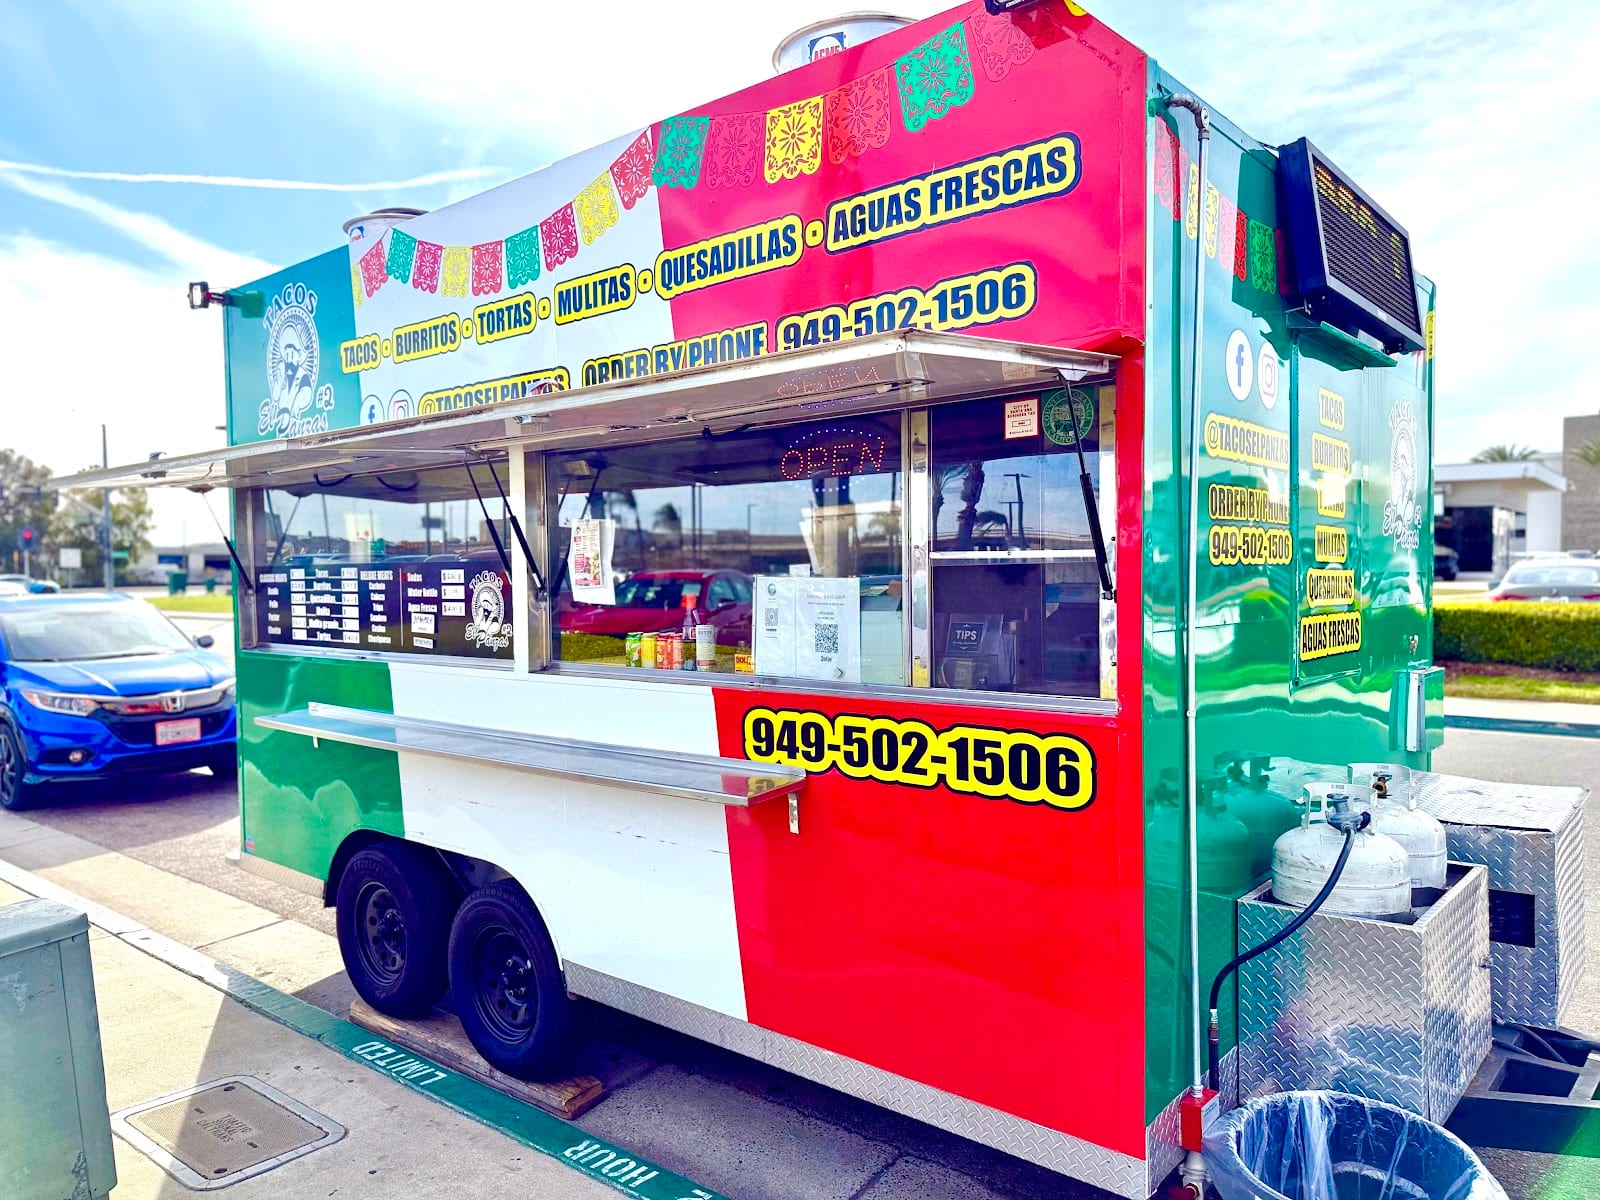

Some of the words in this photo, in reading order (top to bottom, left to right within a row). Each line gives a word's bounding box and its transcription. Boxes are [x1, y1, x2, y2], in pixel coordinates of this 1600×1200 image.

[343, 340, 378, 368] TACOS
[395, 320, 457, 356] BURRITOS
[477, 299, 532, 337] TORTAS
[558, 272, 632, 317] MULITAS
[660, 223, 797, 291] QUESADILLAS
[833, 187, 921, 243] AGUAS
[929, 145, 1067, 217] FRESCAS
[263, 282, 318, 331] TACOS
[585, 353, 649, 387] ORDER
[656, 345, 683, 373] BY
[689, 326, 765, 368] PHONE
[783, 272, 1026, 349] 949-502-1506
[1320, 393, 1343, 425] TACOS
[781, 441, 885, 479] OPEN
[1207, 420, 1289, 465] @TACOSELPANZAS
[1314, 438, 1349, 472] BURRITOS
[1210, 486, 1246, 518] ORDER
[1249, 490, 1261, 520] BY
[1212, 531, 1289, 559] 949-502-1506
[1316, 533, 1345, 558] MULITAS
[469, 570, 504, 590] TACOS
[1309, 573, 1353, 601] QUESADILLAS
[956, 630, 977, 640] TIPS
[1302, 622, 1327, 653] AGUAS
[1329, 617, 1360, 649] FRESCAS
[752, 717, 1081, 797] 949-502-1506
[352, 1041, 448, 1086] LIMITED
[563, 1140, 660, 1188] HOUR
